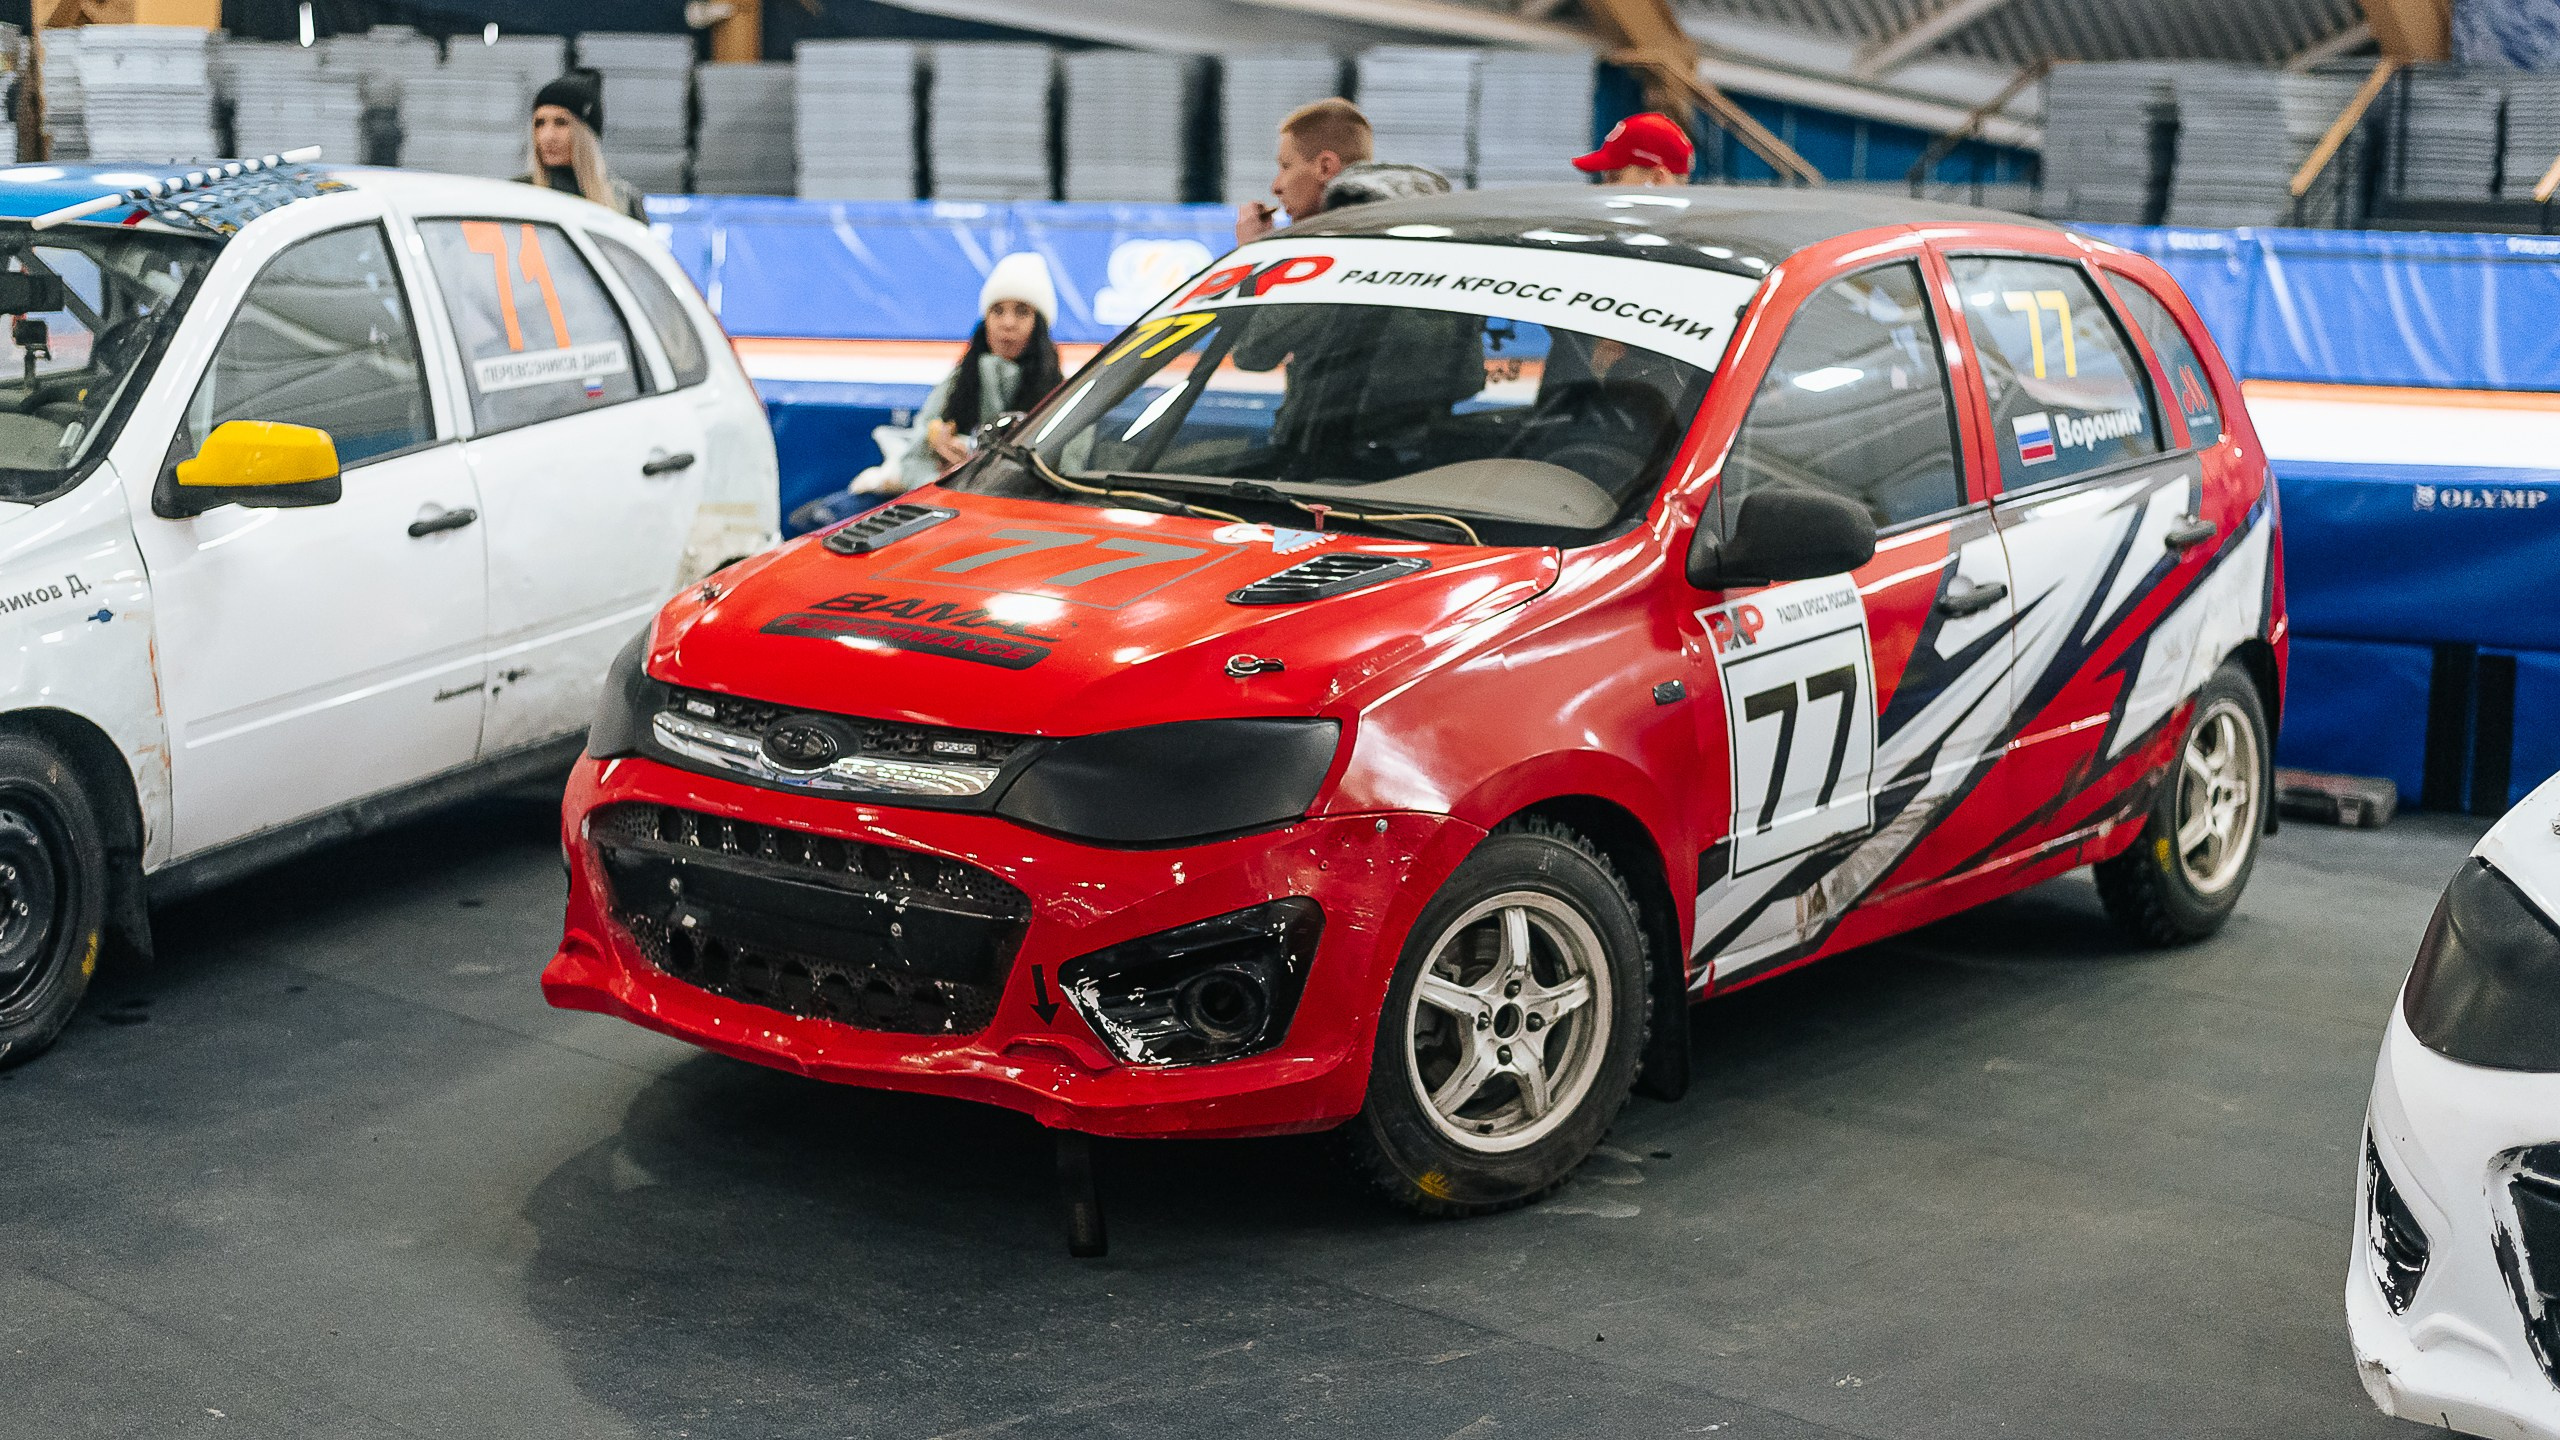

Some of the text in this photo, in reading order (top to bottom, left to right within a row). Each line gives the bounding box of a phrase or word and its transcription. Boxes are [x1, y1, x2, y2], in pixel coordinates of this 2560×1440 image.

[461, 221, 571, 352] 71
[1338, 269, 1714, 342] РАЛЛИ КРОСС РОССИИ
[1103, 312, 1217, 365] 77
[2002, 290, 2077, 378] 77
[2053, 408, 2143, 451] Воронин
[2440, 488, 2548, 509] OLYMP
[933, 529, 1209, 587] 77
[65, 574, 92, 598] Д.
[776, 615, 1036, 661] PERFORMANCE
[1744, 663, 1857, 835] 77
